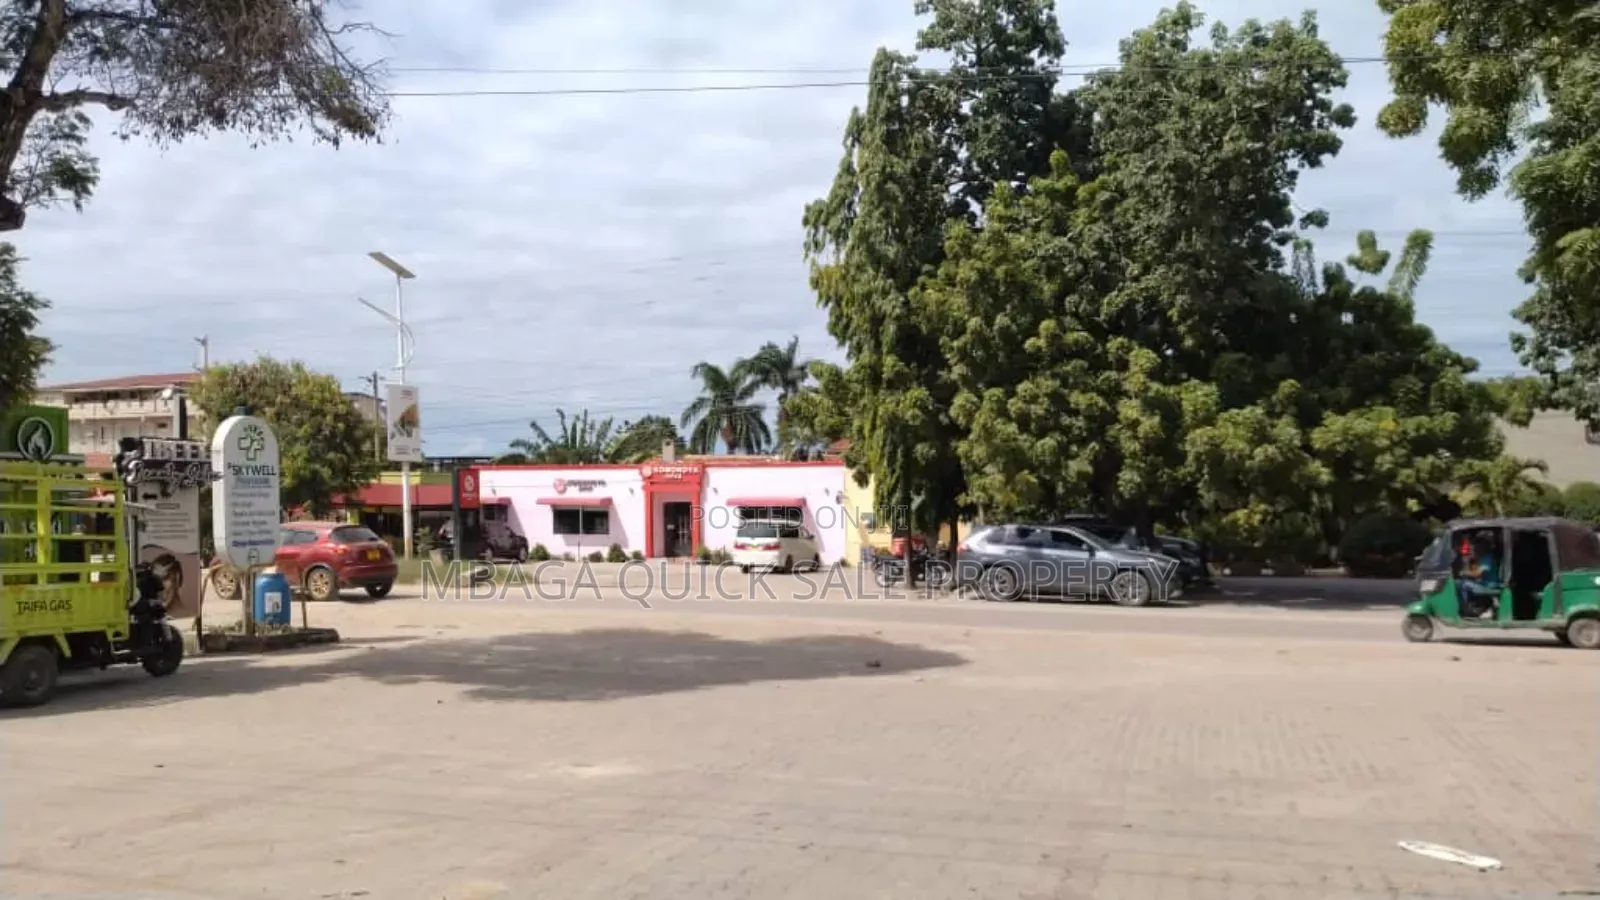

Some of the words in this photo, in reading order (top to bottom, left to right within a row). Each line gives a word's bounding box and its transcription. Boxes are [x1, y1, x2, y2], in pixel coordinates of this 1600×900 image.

[231, 465, 277, 476] SKYWELL
[16, 600, 48, 615] TAIFA
[49, 600, 73, 612] GAS
